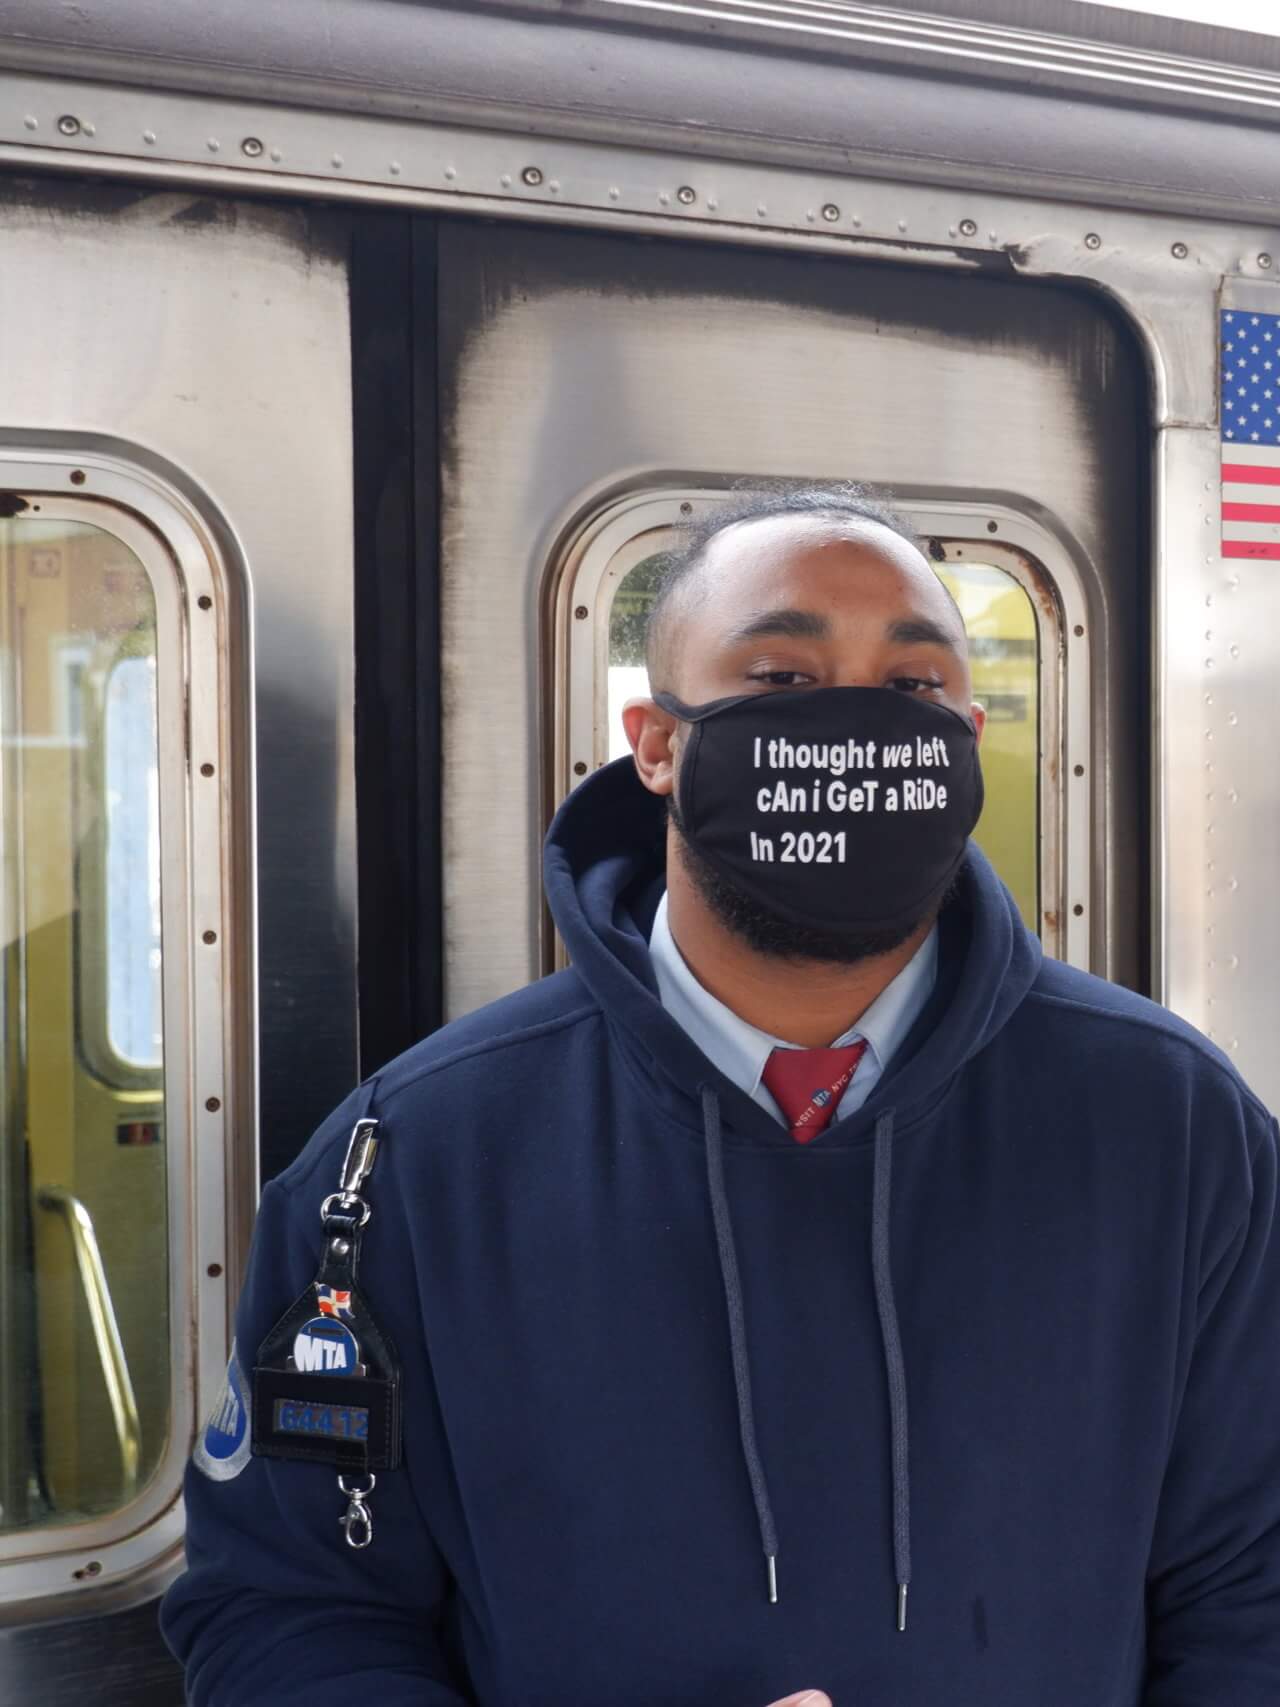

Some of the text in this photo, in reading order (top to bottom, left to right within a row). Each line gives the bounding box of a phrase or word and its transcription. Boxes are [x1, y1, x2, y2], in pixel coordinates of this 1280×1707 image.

[754, 736, 950, 776] I thought we left
[756, 777, 947, 812] cAn i GeT a RiDe
[750, 831, 846, 863] In 2021
[296, 1334, 347, 1372] MTA
